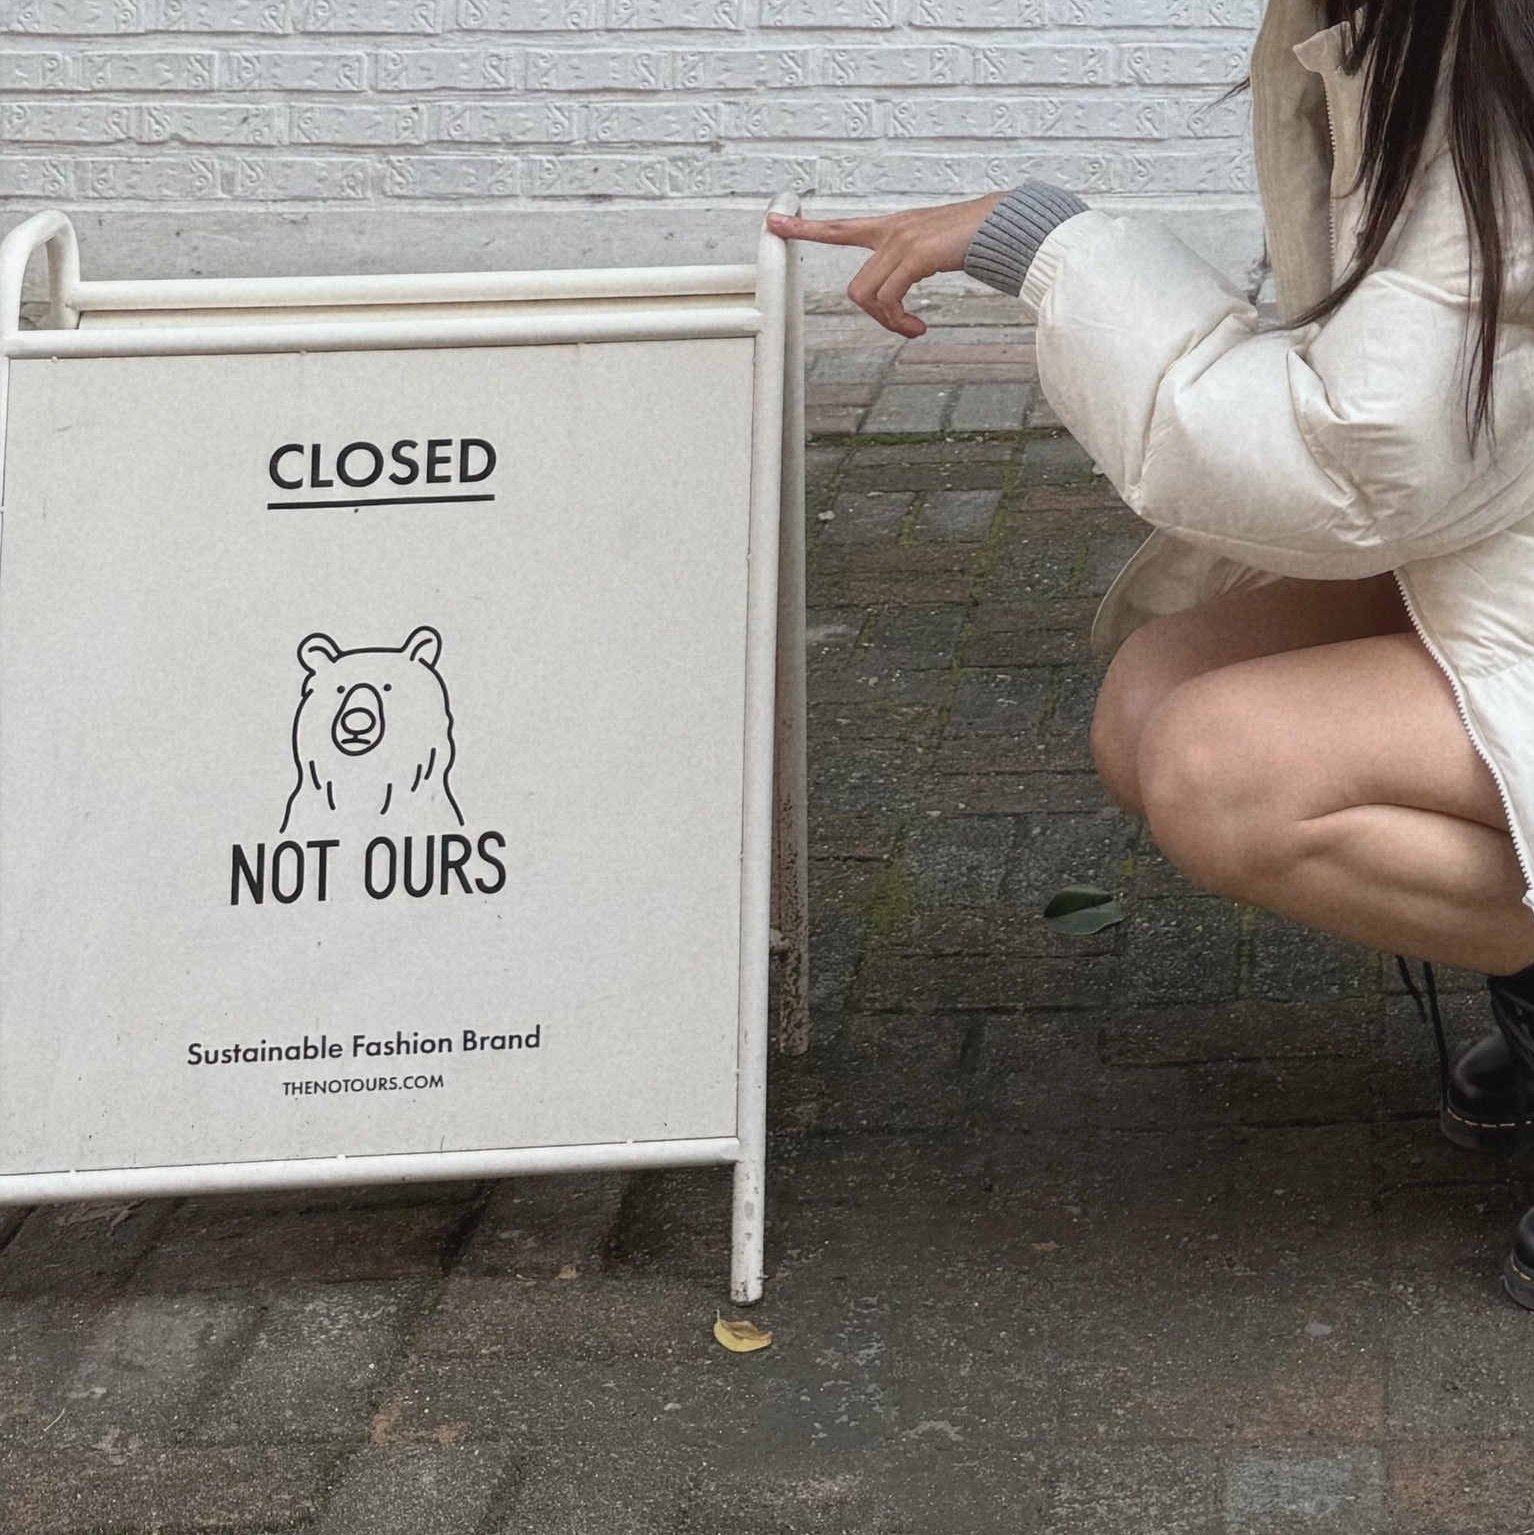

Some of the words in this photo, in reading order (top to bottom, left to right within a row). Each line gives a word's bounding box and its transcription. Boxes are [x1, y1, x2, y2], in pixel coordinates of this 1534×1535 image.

[268, 438, 497, 490] CLOSED
[230, 839, 341, 906] NOT
[364, 830, 507, 901] OURS
[187, 1034, 344, 1066] Sustainable
[353, 1030, 453, 1058] Fashion
[463, 1023, 541, 1053] Brand
[281, 1073, 445, 1097] THENOTOURS.COM
